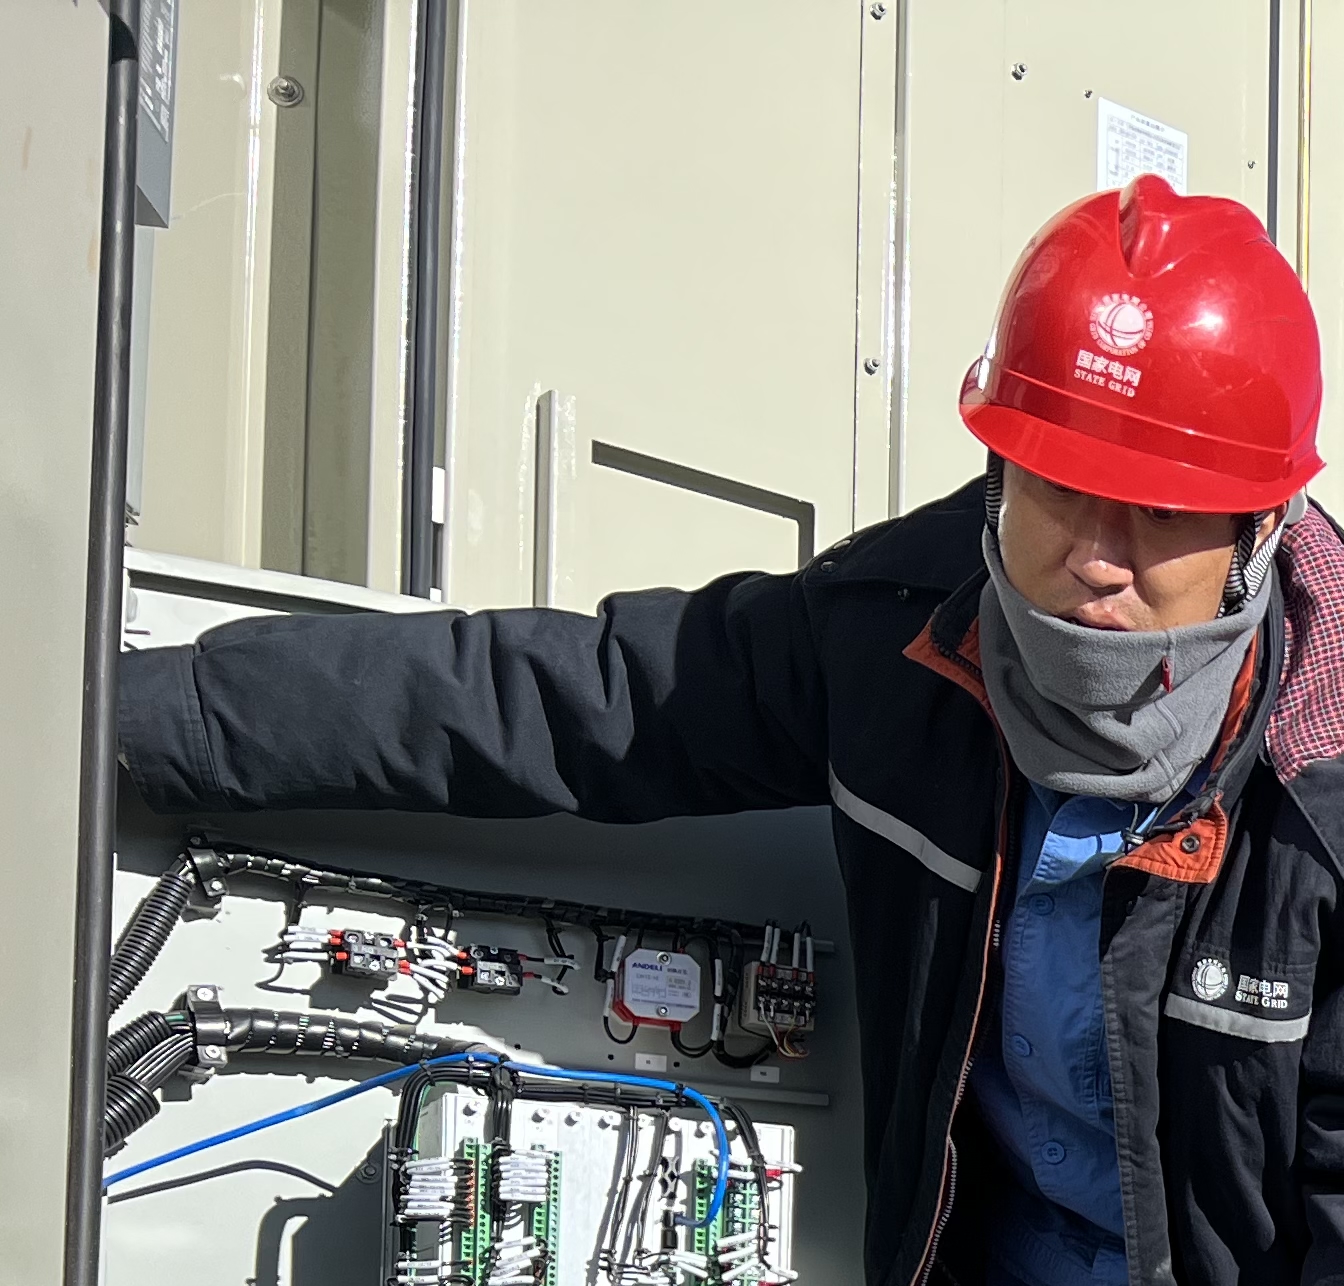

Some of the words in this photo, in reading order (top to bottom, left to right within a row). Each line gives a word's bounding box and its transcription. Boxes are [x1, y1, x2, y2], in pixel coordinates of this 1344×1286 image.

[1076, 349, 1141, 387] 国家电网
[1074, 369, 1106, 387] STATE
[1108, 380, 1135, 398] GRID
[1237, 974, 1289, 999] 国家电网
